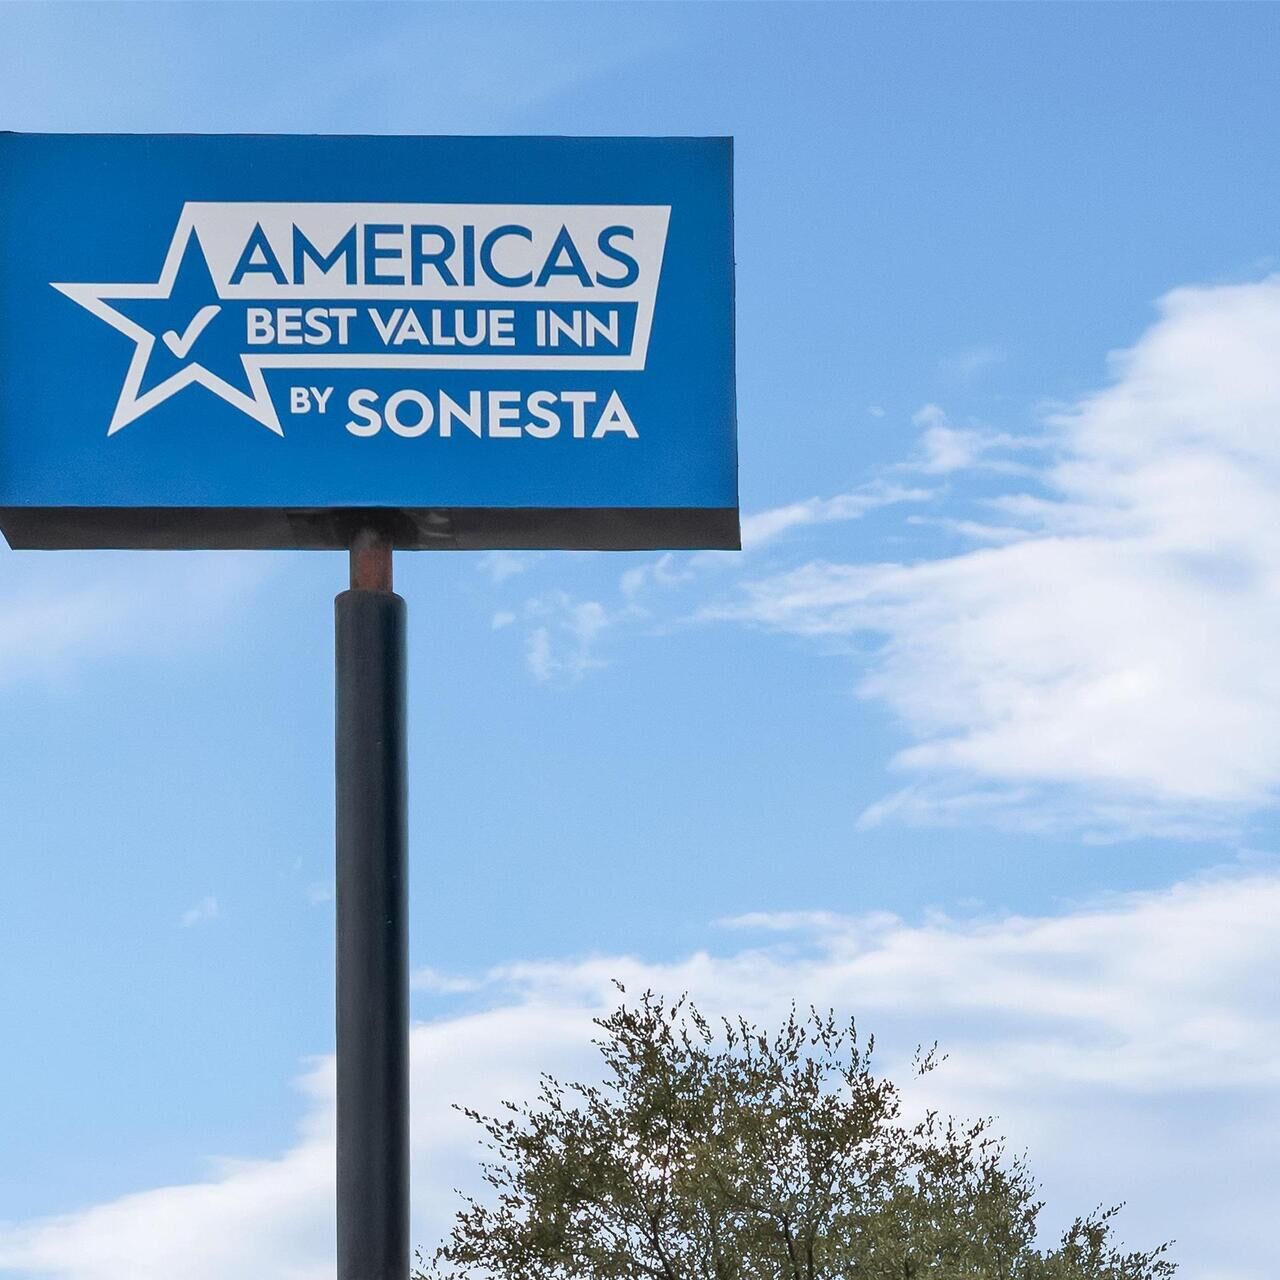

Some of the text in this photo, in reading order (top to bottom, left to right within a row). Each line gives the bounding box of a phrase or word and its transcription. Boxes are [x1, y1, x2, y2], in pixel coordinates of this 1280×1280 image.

[228, 221, 640, 289] AMERICAS
[247, 308, 619, 348] BEST VALUE INN
[290, 386, 640, 439] BY SONESTA
